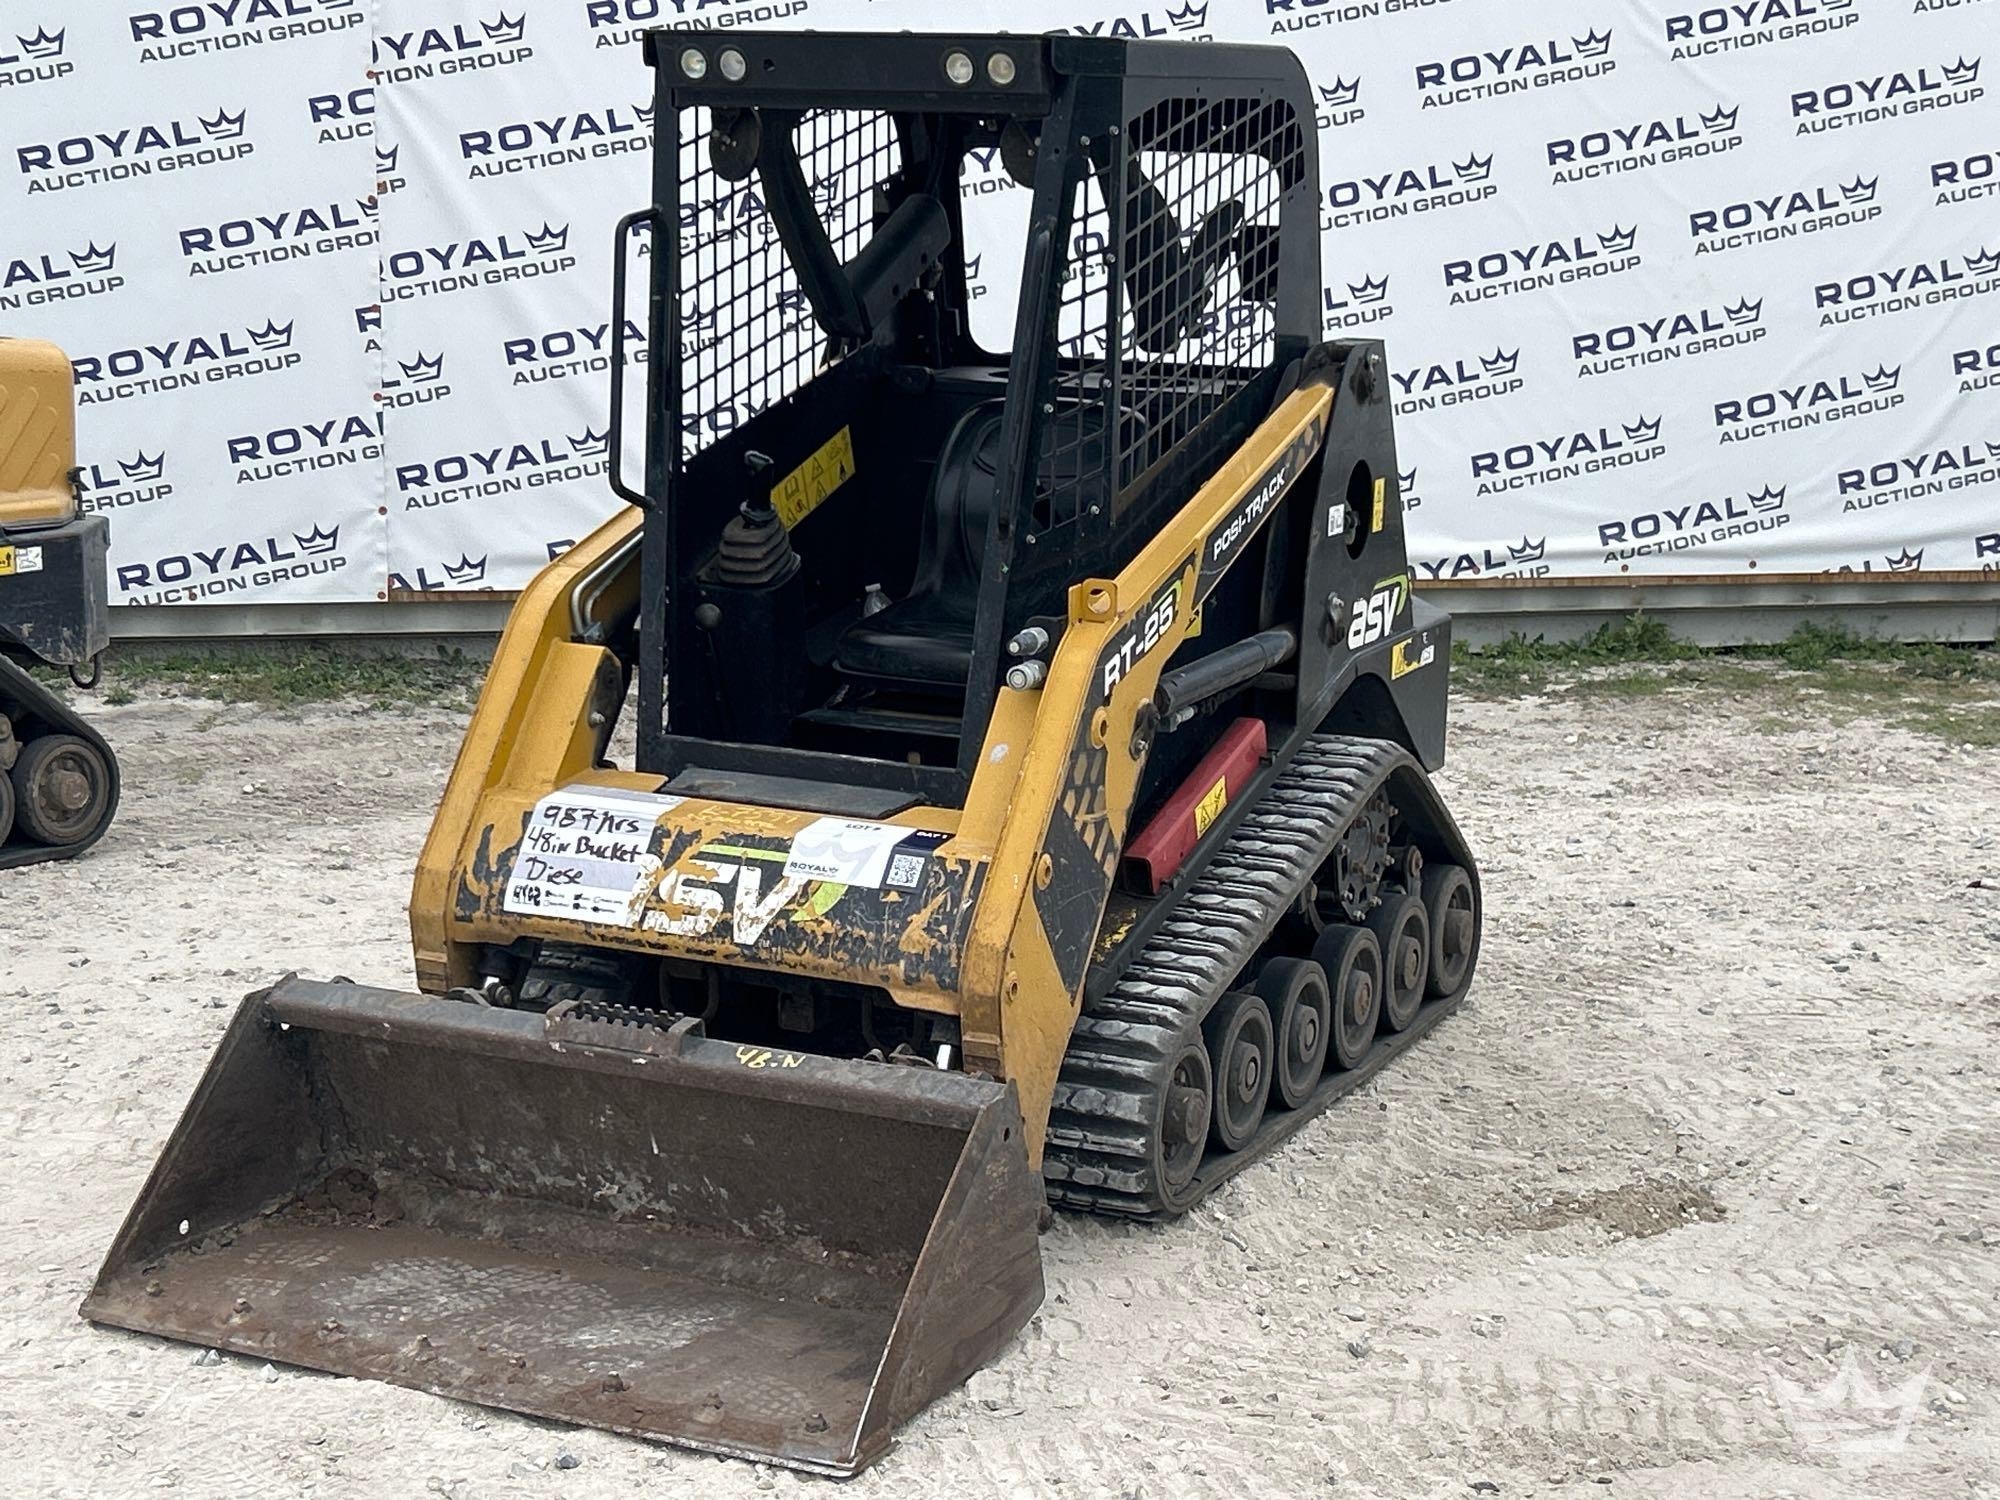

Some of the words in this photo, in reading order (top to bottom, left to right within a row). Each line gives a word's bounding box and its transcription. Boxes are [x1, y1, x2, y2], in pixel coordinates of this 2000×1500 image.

[129, 0, 312, 42] ROYAL
[139, 30, 264, 63] AUCTION
[268, 12, 364, 42] GROUP
[717, 1, 808, 27] GROUP
[1271, 3, 1379, 35] AUCTION
[1666, 0, 1816, 41] ROYAL
[1671, 30, 1773, 61] AUCTION
[1779, 13, 1859, 39] GROUP
[372, 24, 482, 63] YAL
[373, 63, 434, 85] TION
[440, 47, 533, 75] GROUP
[1416, 40, 1572, 90] ROYAL
[0, 62, 74, 88] ROUP
[1421, 77, 1528, 109] AUCTION
[1534, 60, 1616, 87] GROUP
[1791, 68, 1941, 117] ROYAL
[459, 108, 633, 159] ROYAL
[1796, 105, 1898, 136] AUCTION
[1903, 87, 1984, 114] GROUP
[17, 121, 201, 173] ROYAL
[468, 146, 585, 179] AUCTION
[592, 135, 654, 158] GRO
[1547, 118, 1699, 165] ROYAL
[1552, 153, 1656, 185] AUCTION
[1661, 136, 1742, 163] GROUP
[27, 160, 151, 195] AUCTION
[158, 143, 254, 172] GROUP
[1319, 166, 1452, 210] OYAL
[1320, 202, 1408, 231] UCTION
[1413, 185, 1498, 213] GROUP
[1690, 188, 1839, 237] ROYAL
[1935, 182, 2000, 206] AUCT
[179, 204, 358, 256] ROYAL
[189, 242, 310, 277] AUCTION
[316, 230, 379, 253] GRO
[1695, 223, 1797, 256] AUCTION
[1802, 206, 1882, 233] GROUP
[380, 275, 478, 302] UCTION
[485, 256, 576, 284] GROUP
[1444, 237, 1597, 286] ROYAL
[1449, 273, 1554, 306] AUCTION
[1560, 256, 1641, 284] GROUP
[1815, 260, 1963, 308] ROYAL
[27, 276, 125, 308] GROUP
[1819, 295, 1920, 327] AUCTION
[504, 320, 647, 365] ROYA
[1322, 306, 1393, 331] ROUP
[1573, 309, 1723, 359] ROYAL
[70, 333, 249, 385] ROYAL
[1578, 346, 1680, 378] AUCTION
[1686, 327, 1767, 354] GROUP
[78, 371, 200, 406] AUCTION
[206, 353, 301, 382] GROUP
[382, 385, 451, 409] ROUP
[1391, 361, 1480, 394] YAL
[1441, 379, 1523, 406] GROUP
[1714, 377, 1863, 426] ROYAL
[1719, 412, 1820, 445] AUCTION
[1826, 394, 1905, 421] GROUP
[237, 450, 356, 484] AUCTION
[396, 440, 569, 491] ROYAL
[1471, 428, 1622, 477] ROYAL
[1476, 463, 1579, 497] AUCTION
[1585, 446, 1666, 473] GROUP
[1838, 445, 1985, 495] ROYAL
[405, 477, 520, 511] AUCTION
[1213, 467, 1285, 561] POSI-TRACK
[1843, 480, 1943, 513] AUCTION
[1948, 468, 2000, 489] GRO
[1598, 497, 1748, 547] ROYAL
[1604, 525, 1707, 563] AUCTION
[1711, 514, 1790, 542] GROUP
[117, 538, 295, 590] ROYAL
[252, 556, 347, 585] GROUP
[1407, 550, 1506, 580] YAL
[1104, 594, 1174, 697] RT-25
